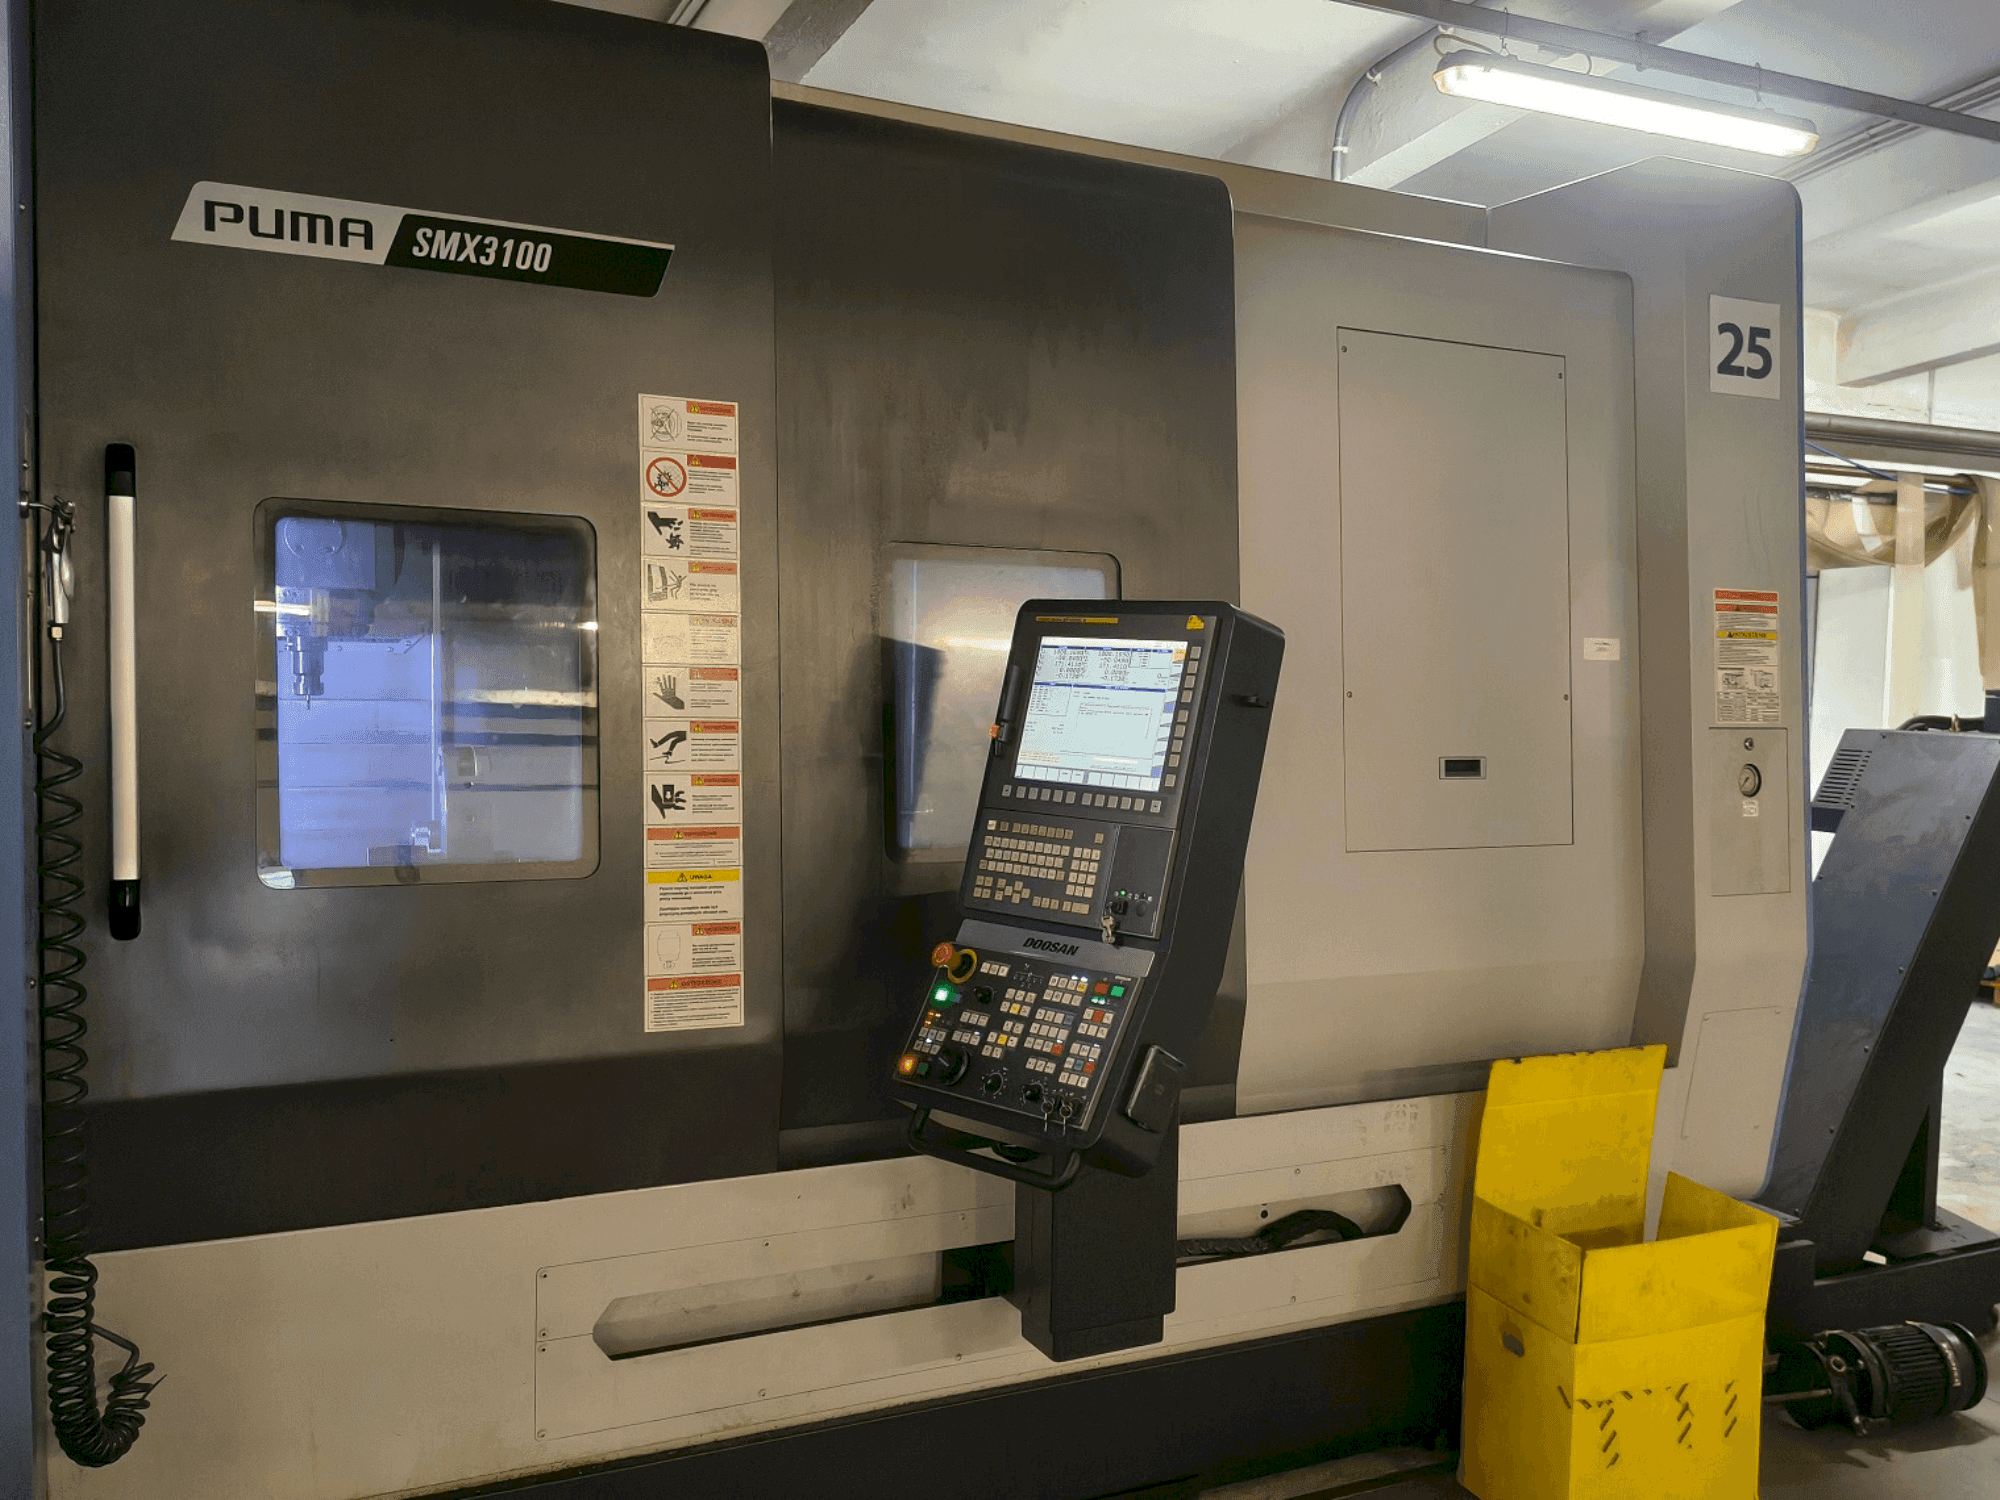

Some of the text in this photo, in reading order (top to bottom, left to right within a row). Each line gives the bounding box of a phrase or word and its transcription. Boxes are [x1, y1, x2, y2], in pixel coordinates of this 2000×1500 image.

[204, 200, 373, 250] PUMA
[412, 227, 552, 272] SMX3100
[1717, 322, 1772, 379] 25
[1023, 937, 1079, 955] DOOSAN
